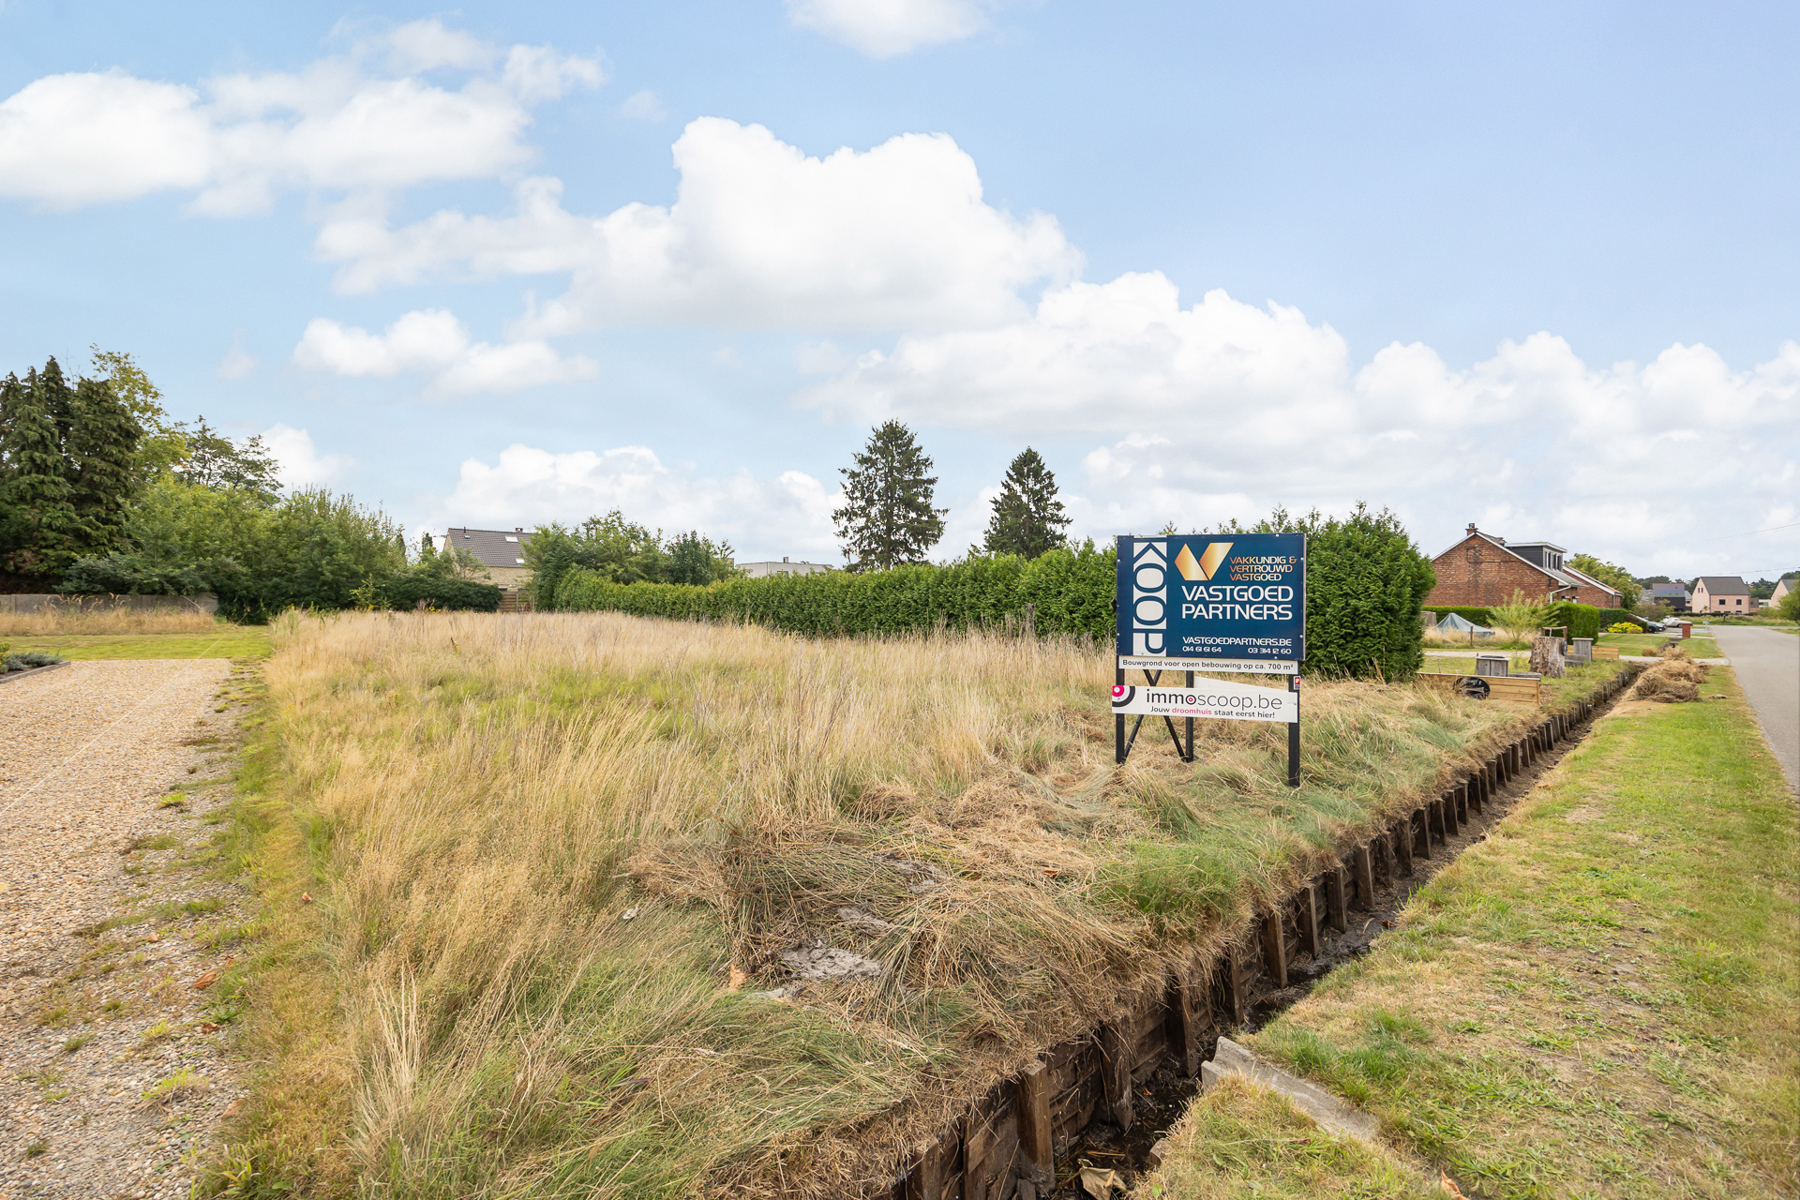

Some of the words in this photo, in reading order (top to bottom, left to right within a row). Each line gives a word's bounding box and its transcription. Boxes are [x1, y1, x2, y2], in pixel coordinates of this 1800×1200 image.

[1229, 556, 1286, 565] VAKKUNDIG
[1289, 556, 1297, 564] &
[1229, 564, 1293, 573] VERTROUWD
[1229, 573, 1282, 581] VASTGOED
[1133, 537, 1167, 655] KOOP
[1181, 585, 1294, 602] VASTGOED
[1182, 603, 1293, 620] PARTNERS
[1182, 636, 1292, 647] VASTGOEDPARTNERS.BE
[1122, 659, 1162, 668] Bouwgrond
[1201, 661, 1241, 670] bebouwing
[1146, 688, 1283, 711] immoscoop.be
[1171, 706, 1212, 715] droomhuis
[1257, 711, 1275, 719] hier!
